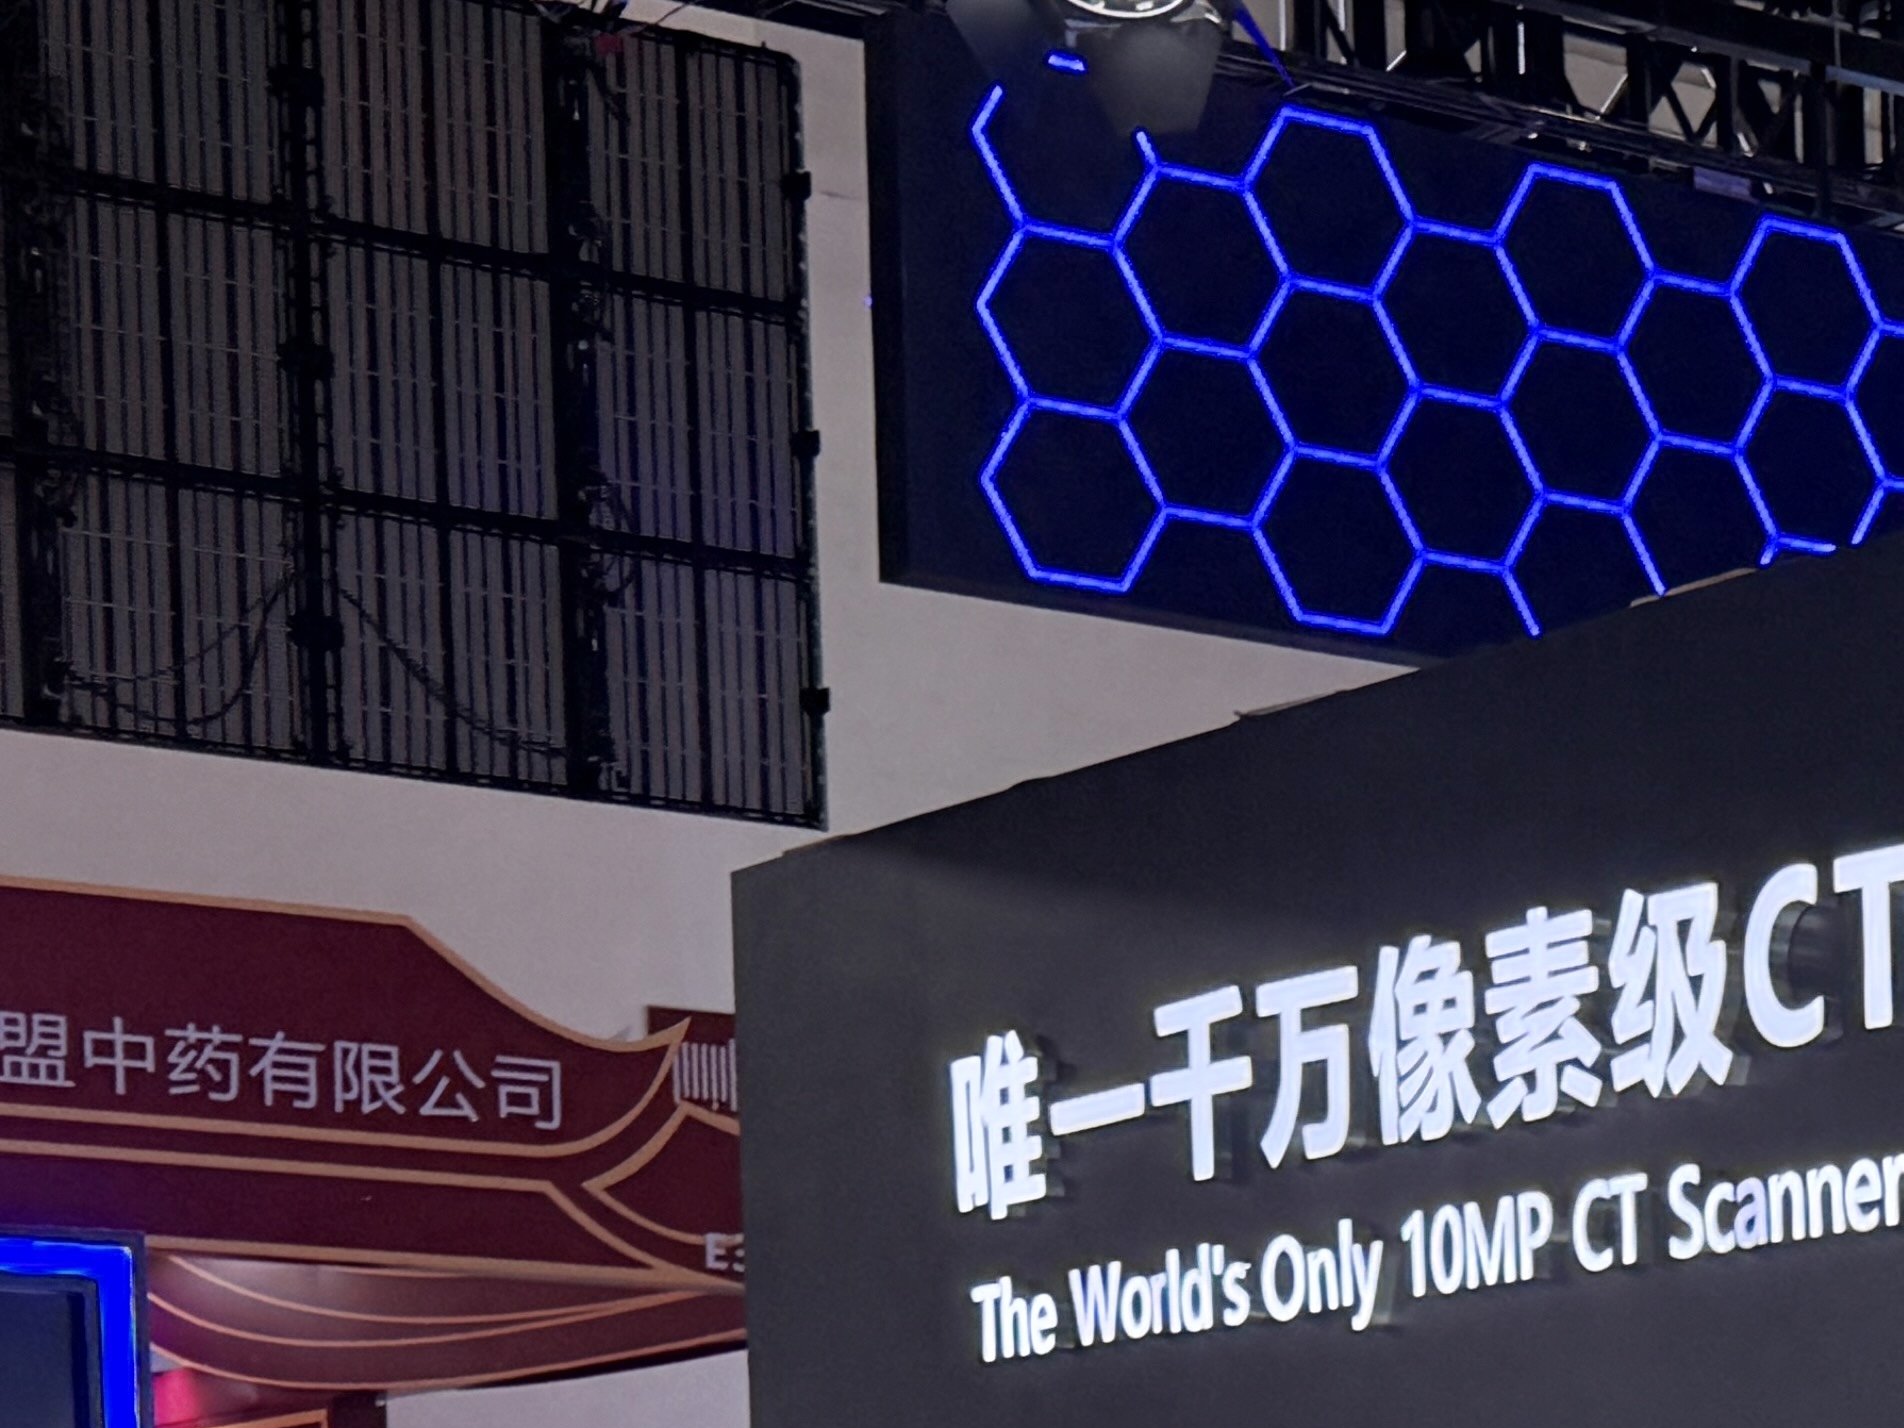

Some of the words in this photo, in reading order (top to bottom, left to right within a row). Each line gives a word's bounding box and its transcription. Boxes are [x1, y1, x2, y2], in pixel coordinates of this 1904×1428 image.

[0, 1010, 563, 1131] 盟中药有限公司
[971, 1277, 1058, 1364] The
[1068, 1242, 1252, 1346] World's
[1259, 1217, 1385, 1332] Only
[1399, 1190, 1555, 1299] 10MP
[1570, 1172, 1649, 1273] CT
